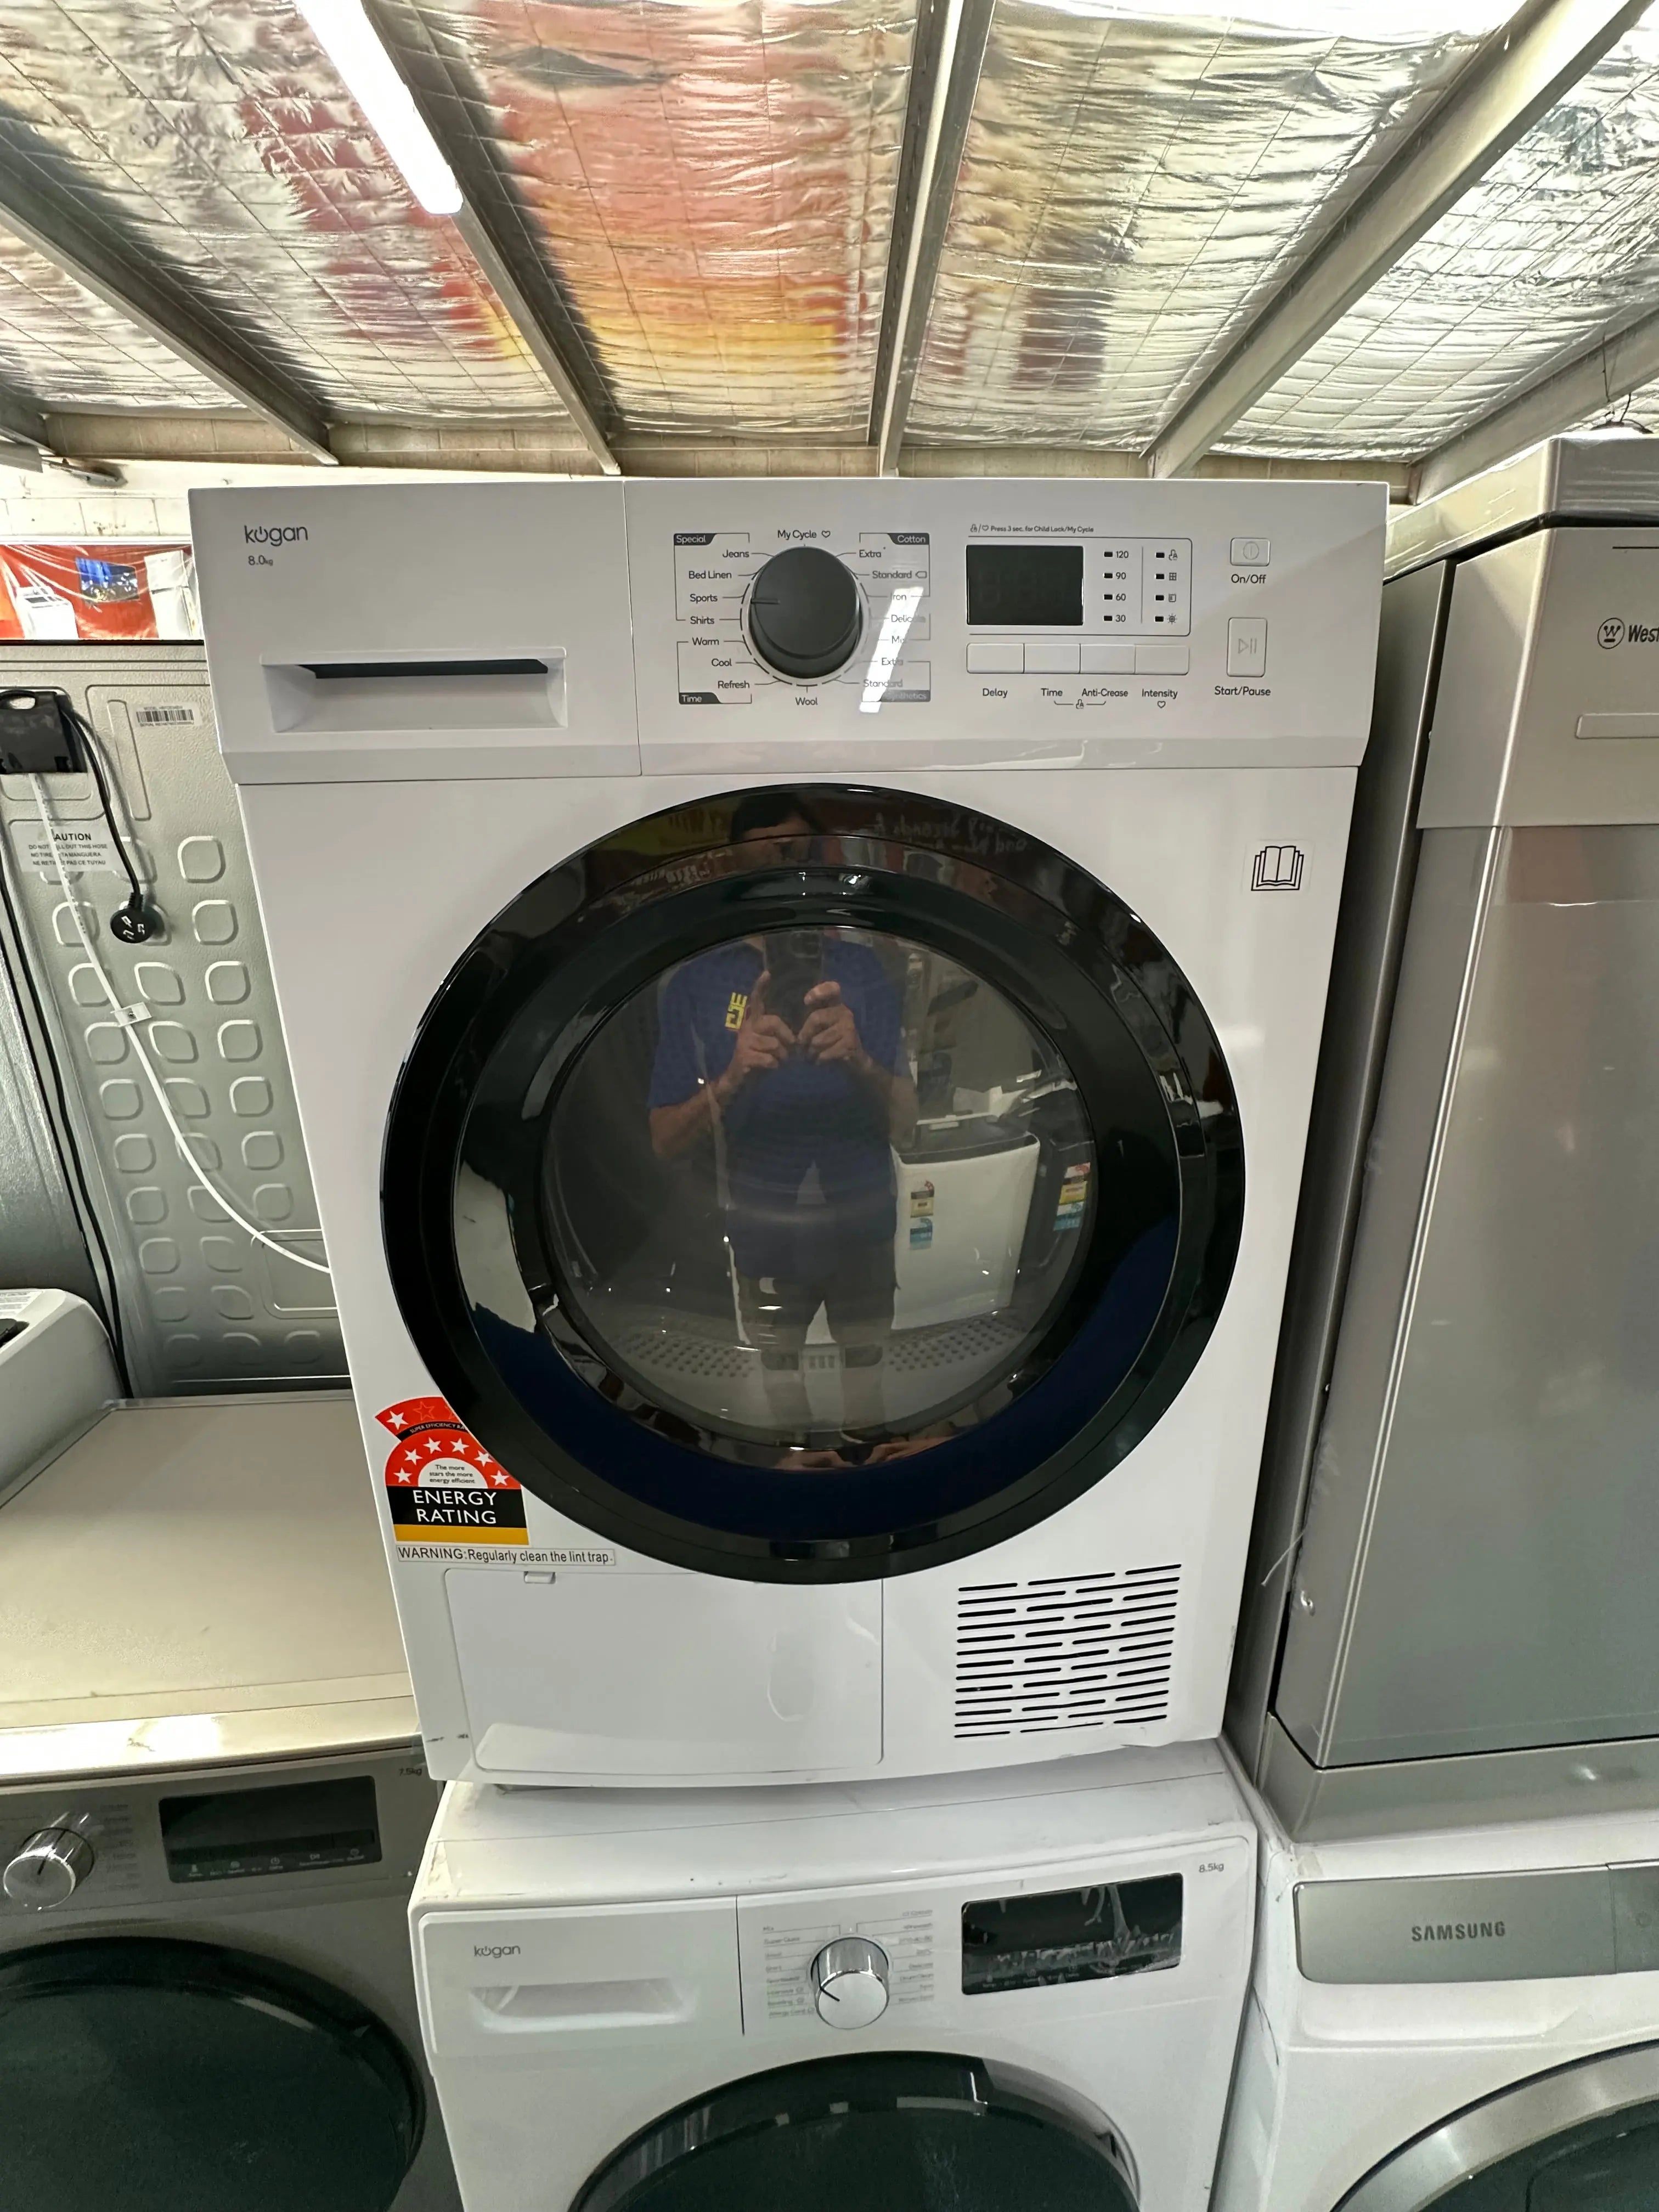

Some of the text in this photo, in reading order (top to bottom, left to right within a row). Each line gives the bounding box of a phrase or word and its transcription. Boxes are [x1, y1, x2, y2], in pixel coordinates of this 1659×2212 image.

[244, 525, 308, 546] kogan
[777, 529, 817, 540] My Cycle
[676, 535, 706, 544] Special
[722, 549, 749, 558] Jeans
[859, 550, 882, 558] Extra
[248, 555, 273, 566] 8.0kg
[689, 571, 732, 579] Bed Linen
[872, 571, 912, 579] Standard
[1231, 574, 1266, 585] On/Off
[690, 594, 718, 603] Sports
[1115, 593, 1126, 601] 60
[690, 616, 715, 624] Shirts
[891, 614, 926, 623] Delic
[692, 637, 719, 646] Warm
[711, 658, 732, 667] Cool
[718, 680, 750, 689] Refresh
[982, 688, 1008, 699] Delay
[1041, 688, 1063, 697] Time
[1081, 689, 1128, 697] Anti-Crease
[1142, 689, 1178, 699] Intensity
[1214, 686, 1271, 698] Start/Pause
[681, 694, 702, 703] Time
[795, 697, 818, 706] Wool
[413, 1490, 497, 1506] ENERGY
[416, 1509, 496, 1524] RATING
[520, 1550, 548, 1562] clean
[550, 1551, 567, 1562] the
[569, 1551, 586, 1562] lint
[1199, 1863, 1224, 1873] 8.5kg
[1412, 1921, 1506, 1942] SAMSUNG
[473, 1945, 521, 1959] kogan
